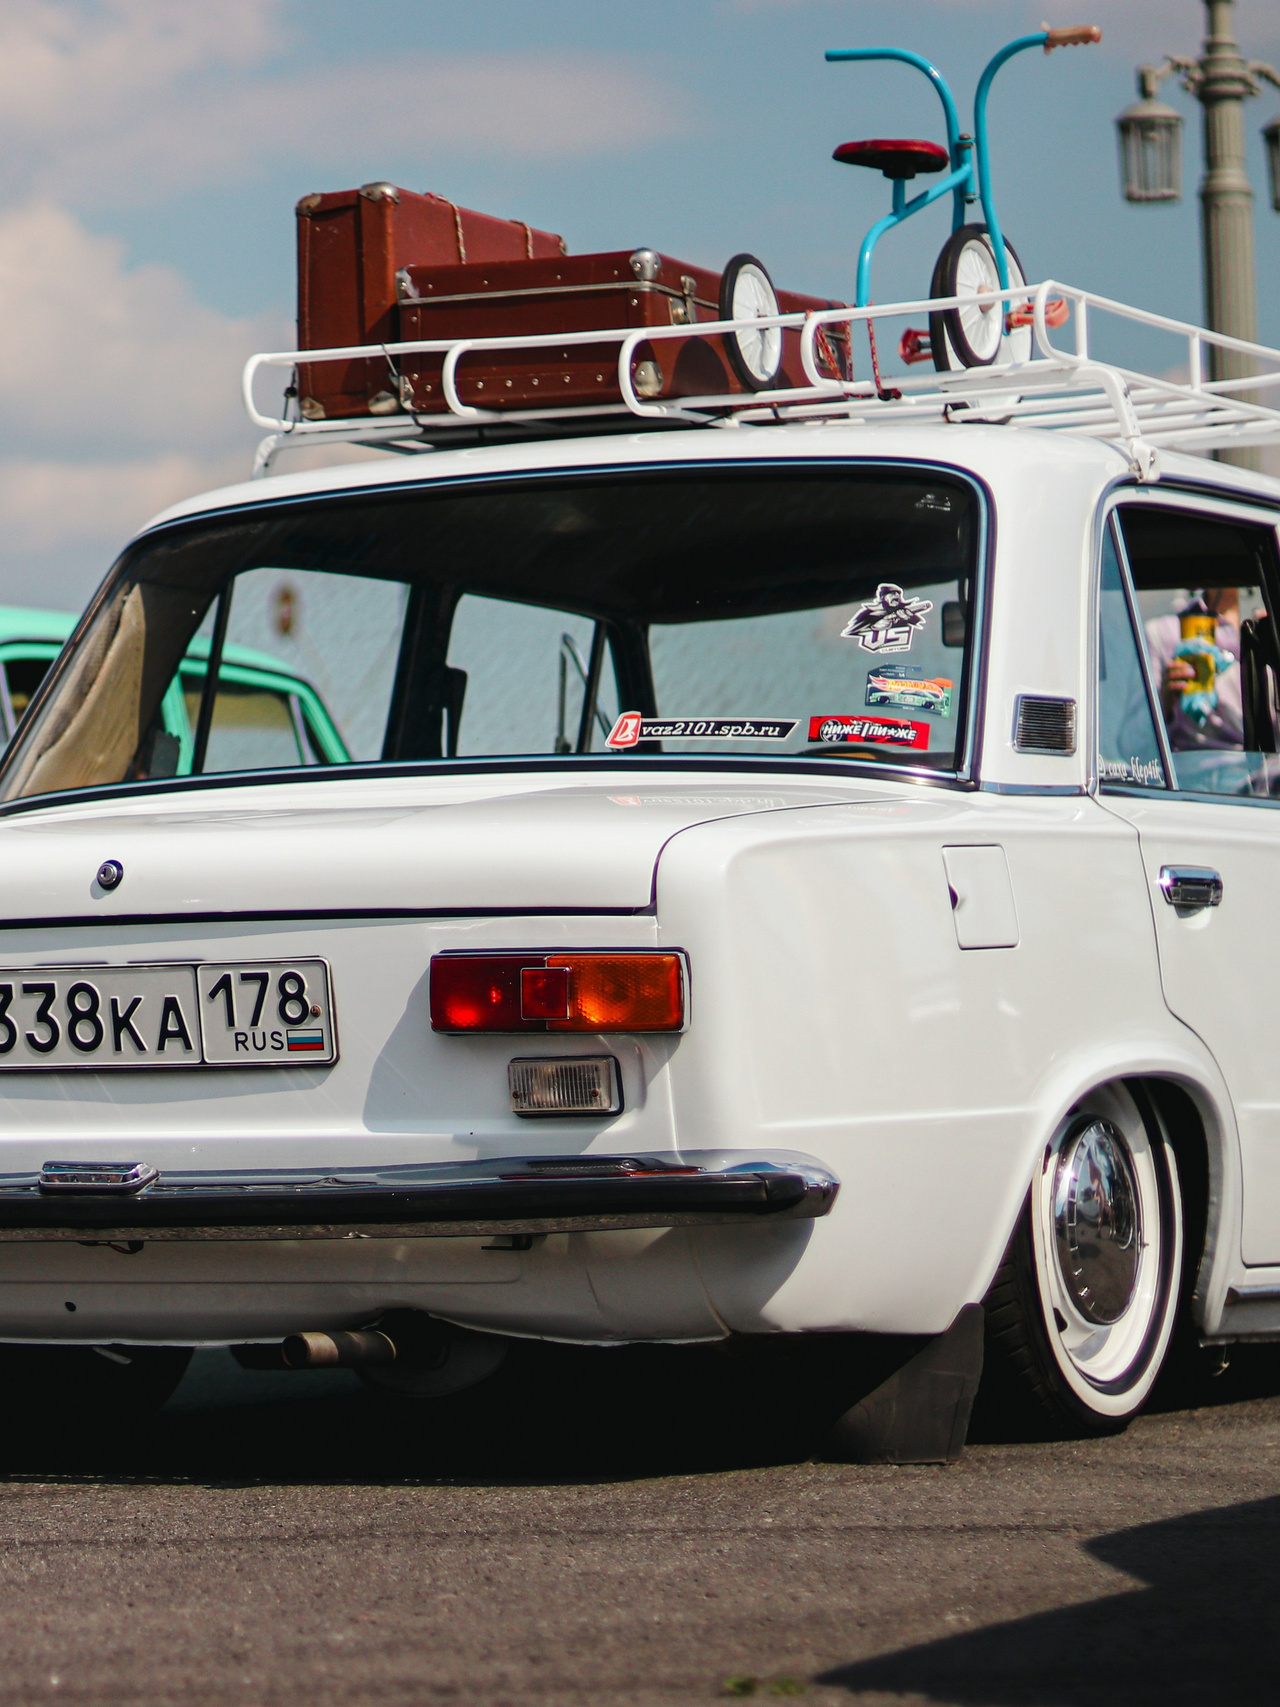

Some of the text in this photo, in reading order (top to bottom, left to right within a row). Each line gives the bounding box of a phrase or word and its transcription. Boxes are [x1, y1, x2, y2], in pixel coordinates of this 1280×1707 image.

[864, 626, 911, 648] US
[642, 721, 781, 737] vaz2101.spb.ru
[208, 971, 310, 1028] 178
[234, 1030, 285, 1052] RUS
